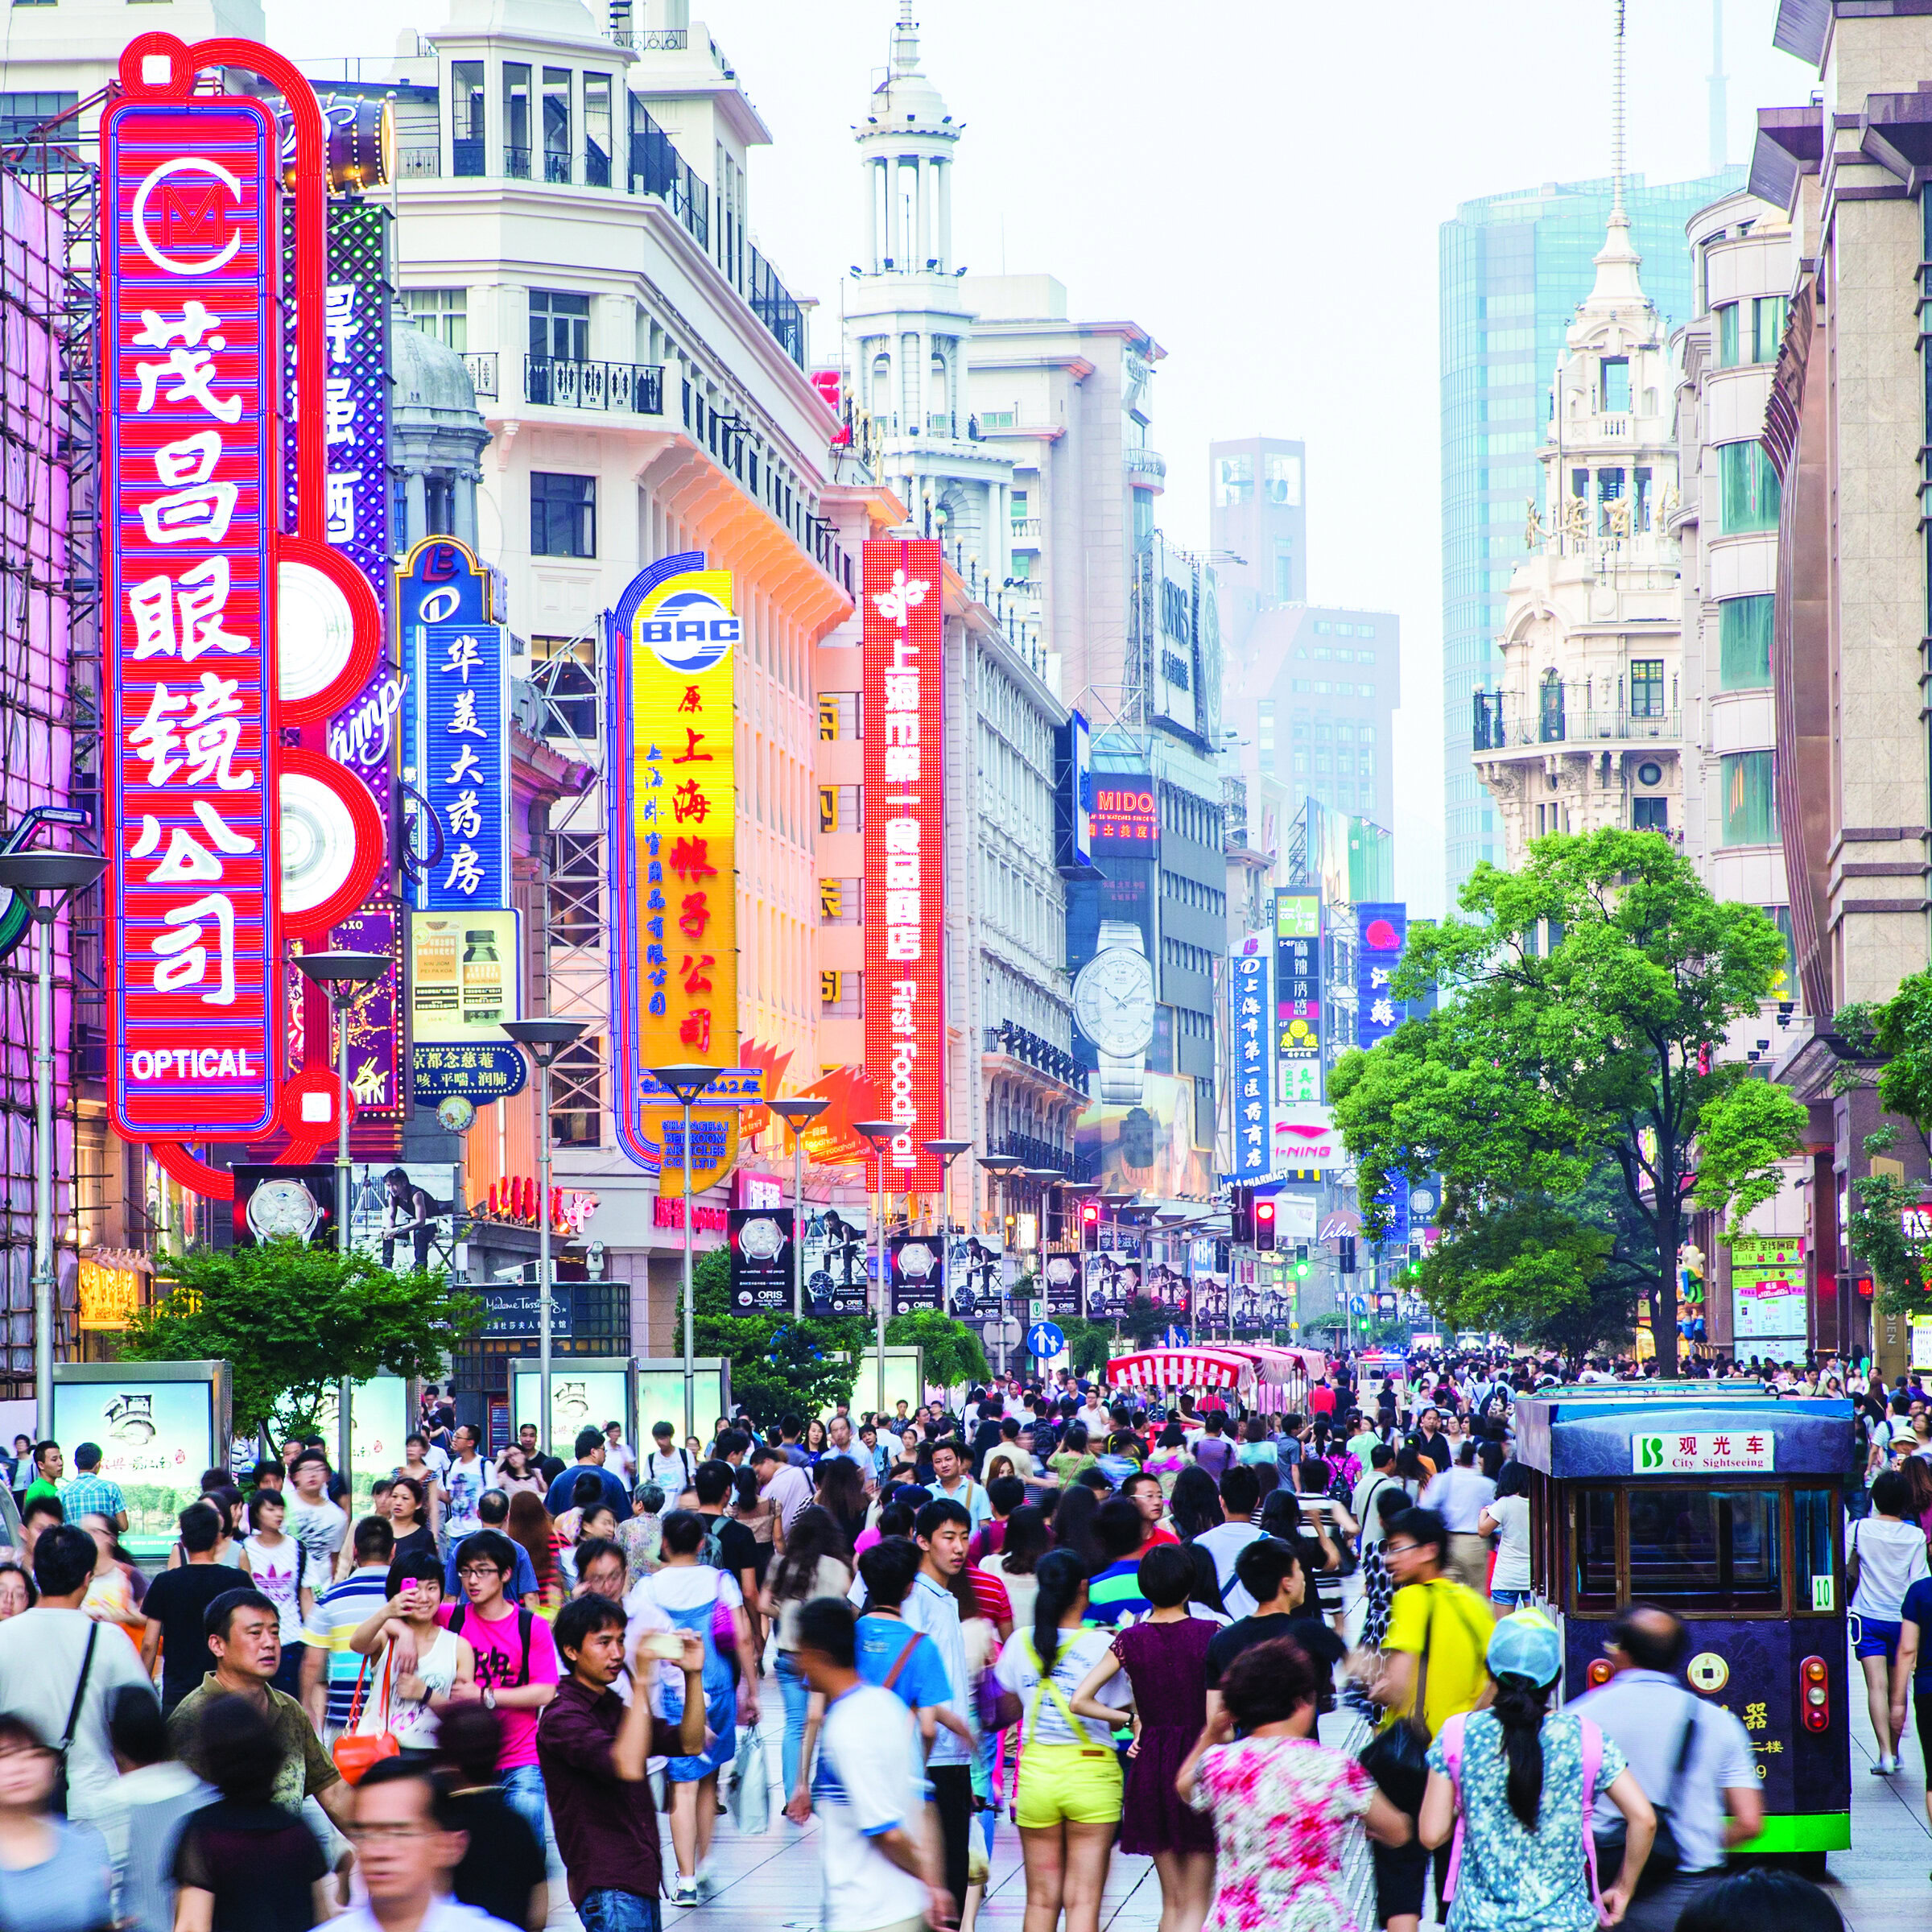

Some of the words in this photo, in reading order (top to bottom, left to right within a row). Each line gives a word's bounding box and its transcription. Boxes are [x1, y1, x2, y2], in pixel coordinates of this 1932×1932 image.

[1162, 576, 1189, 644] ORIS
[642, 620, 739, 642] BAC
[129, 300, 255, 1006] 茂昌眼镜公司
[440, 634, 485, 895] 华美大药房
[885, 638, 921, 960] 上海市第一食品商店
[1098, 791, 1153, 812] MIDO
[892, 980, 917, 1035] First
[131, 1049, 256, 1080] OPTICAL
[413, 1071, 507, 1087] 咳、平喘、润肺
[1241, 978, 1263, 1167] 上海市第一医药商店
[758, 1290, 783, 1299] ORIS
[1679, 1435, 1764, 1455] 观光车
[1673, 1458, 1695, 1468] City
[1703, 1458, 1764, 1468] Sightseeing
[1816, 1579, 1830, 1607] 10
